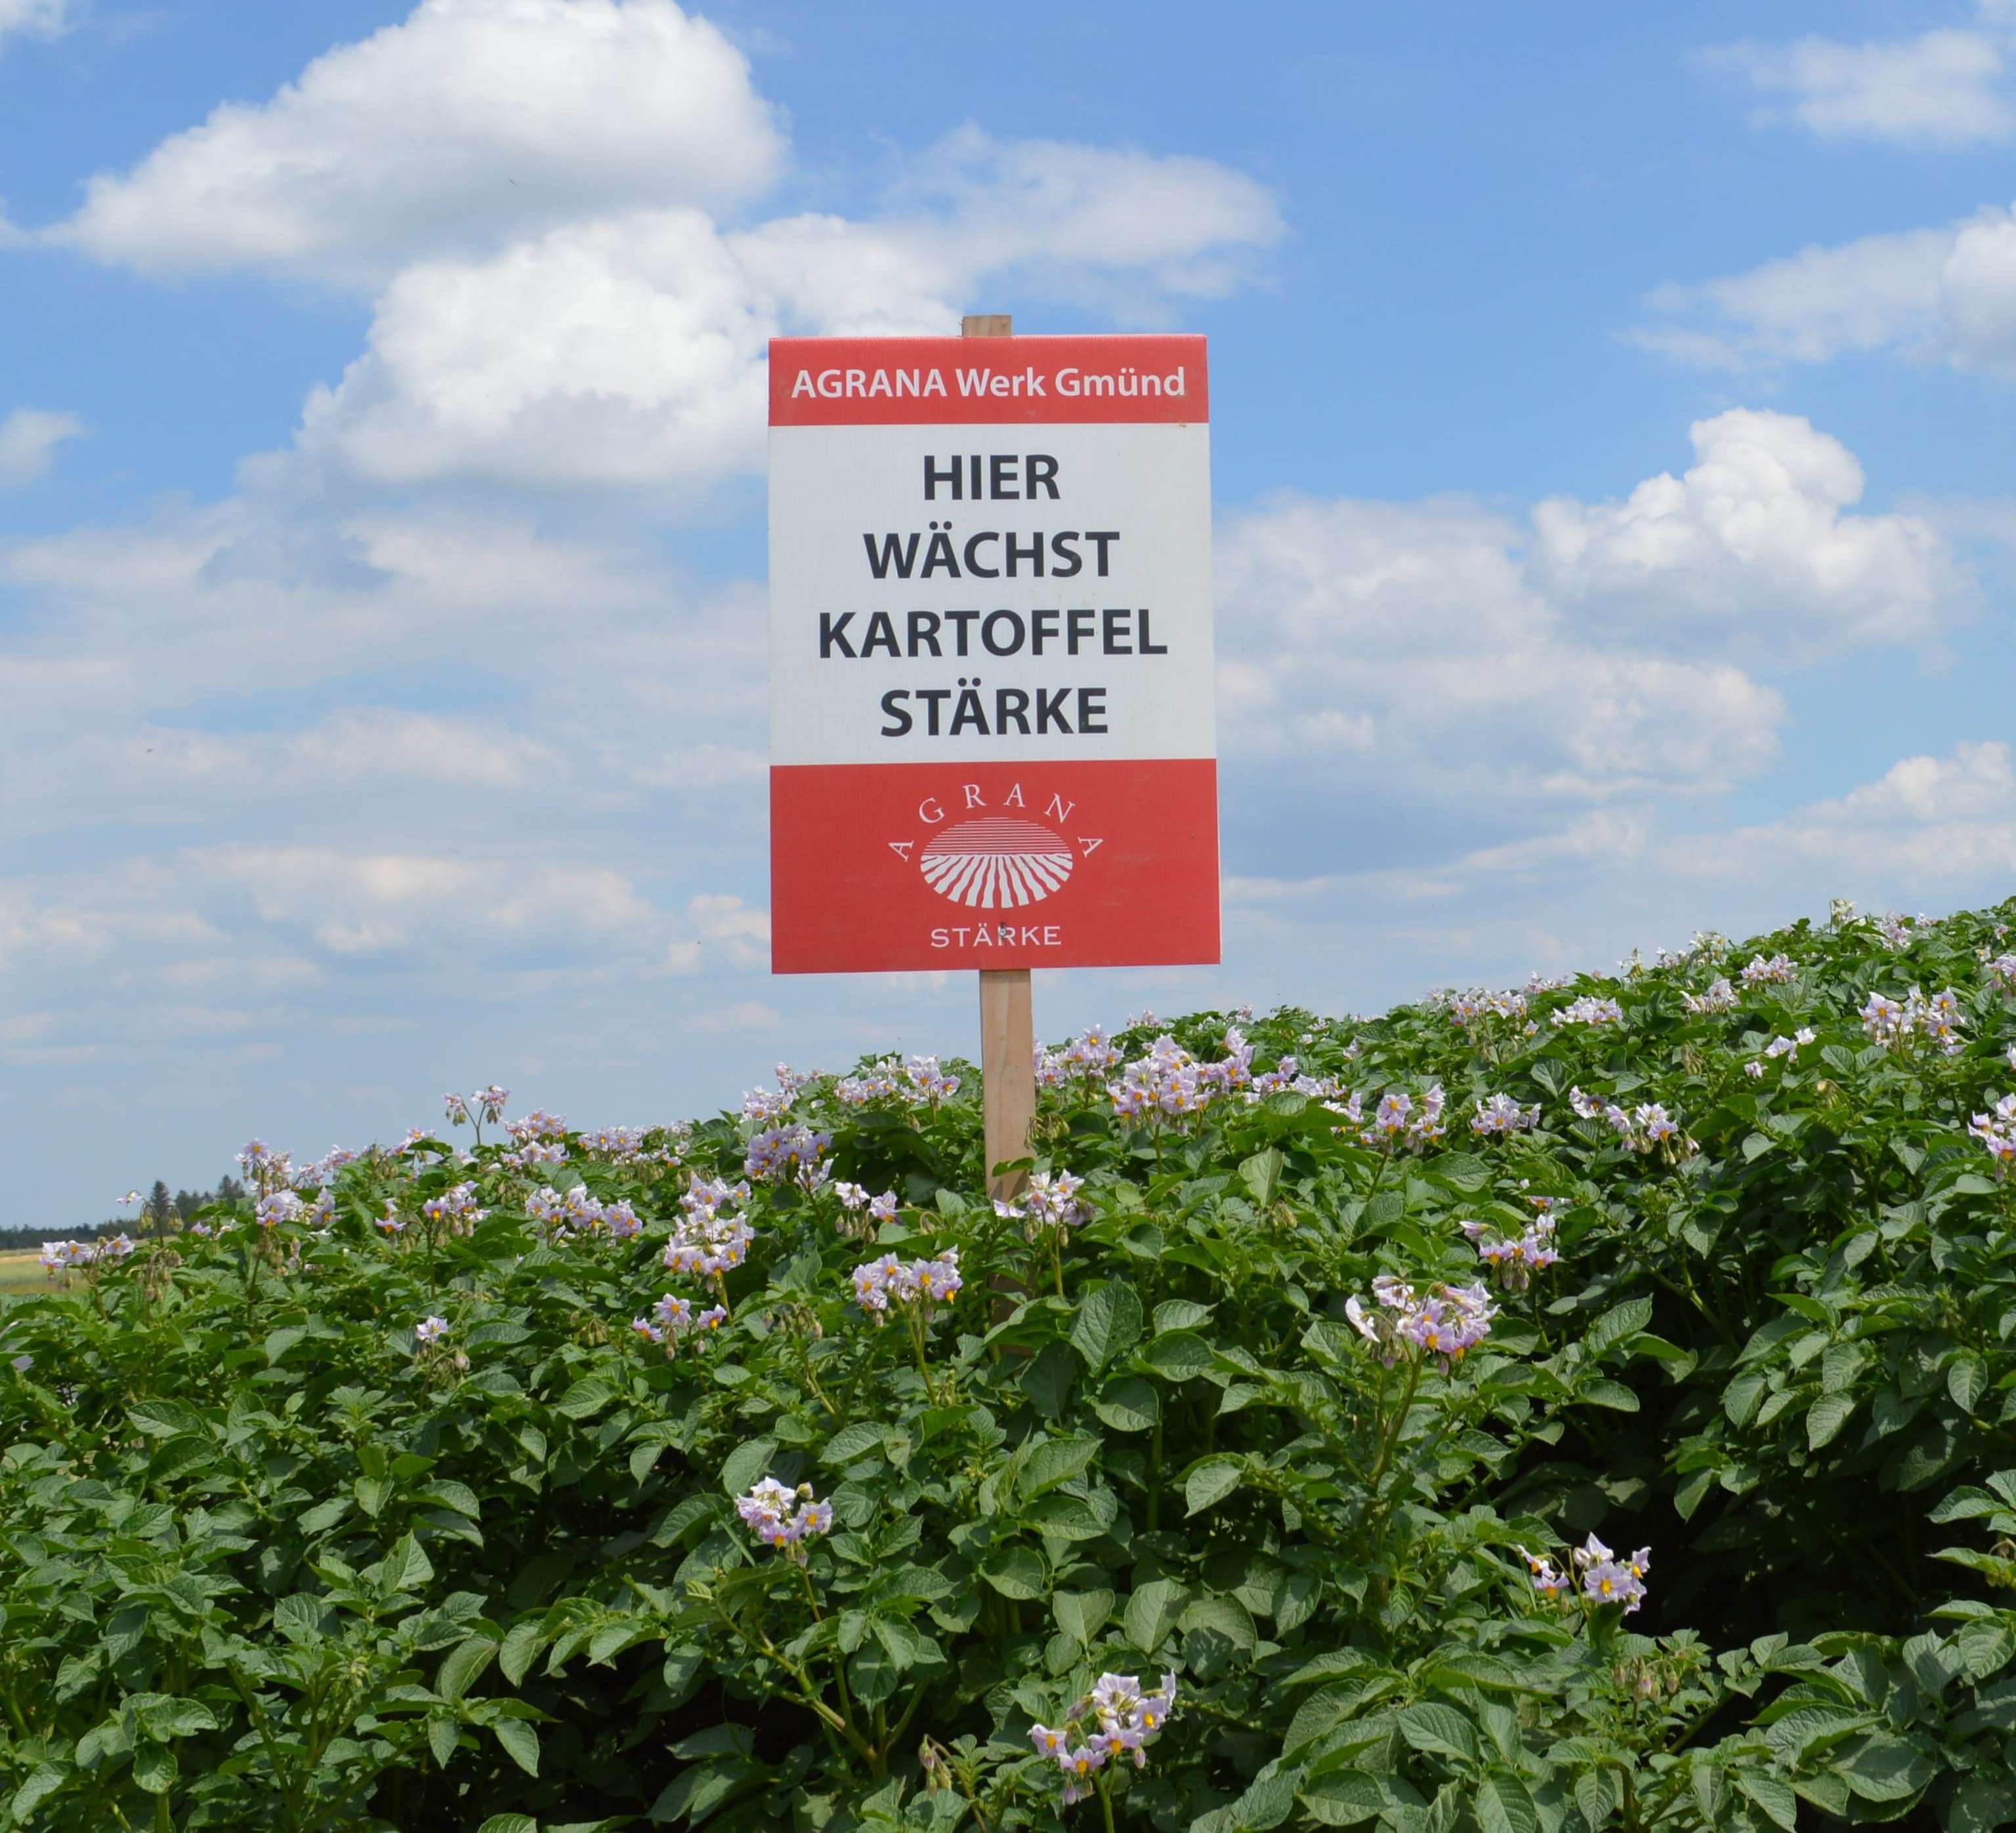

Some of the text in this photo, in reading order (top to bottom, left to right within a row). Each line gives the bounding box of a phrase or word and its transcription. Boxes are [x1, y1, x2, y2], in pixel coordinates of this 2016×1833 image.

[791, 366, 1187, 399] AGRANA Werk Gmünd
[924, 454, 1060, 500] HIER
[863, 521, 1120, 579] WÄCHST
[820, 609, 1167, 658] KARTOFFEL
[881, 677, 1108, 737] STÄRKE
[888, 783, 1104, 862] AGRANA
[931, 922, 1062, 948] STÄRKE
